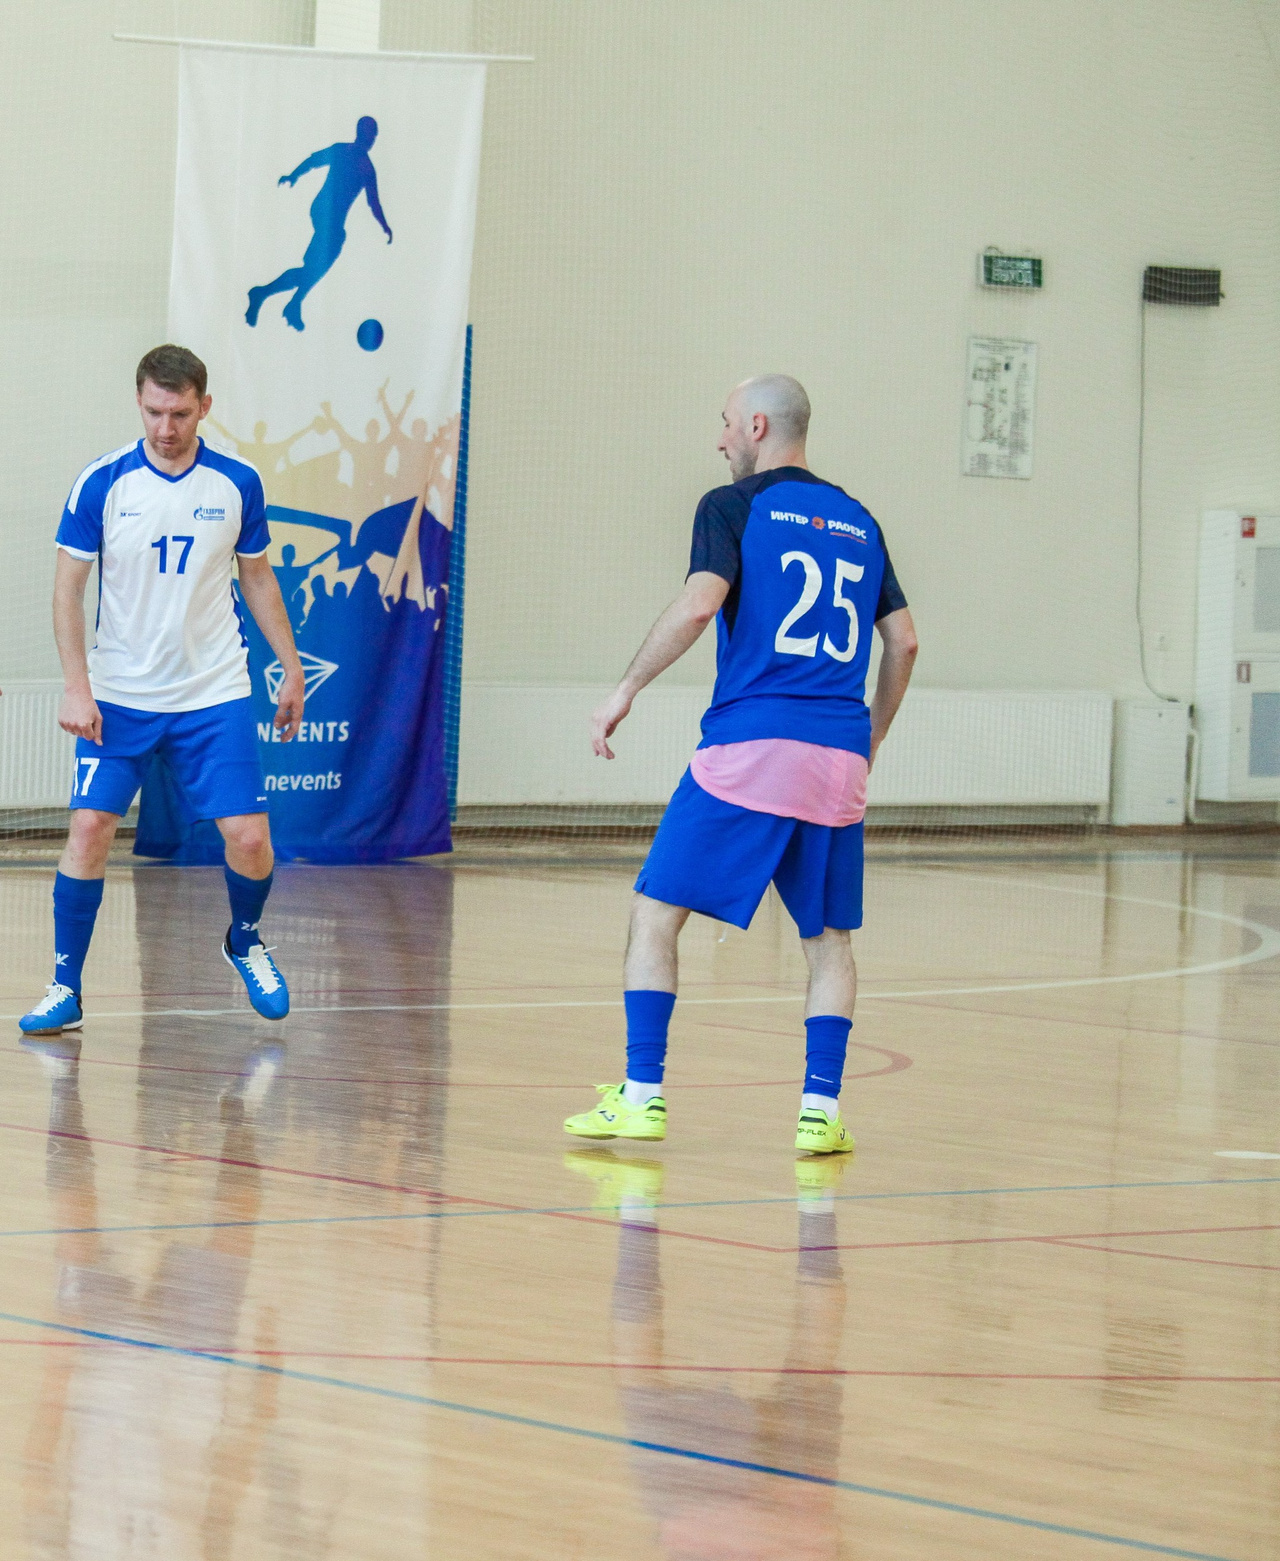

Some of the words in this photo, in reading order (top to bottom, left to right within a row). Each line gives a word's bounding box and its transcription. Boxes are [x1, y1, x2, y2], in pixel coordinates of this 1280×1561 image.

[770, 510, 809, 526] ИНТЕР
[151, 535, 195, 575] 17
[774, 550, 865, 663] 25
[264, 771, 342, 792] nevents
